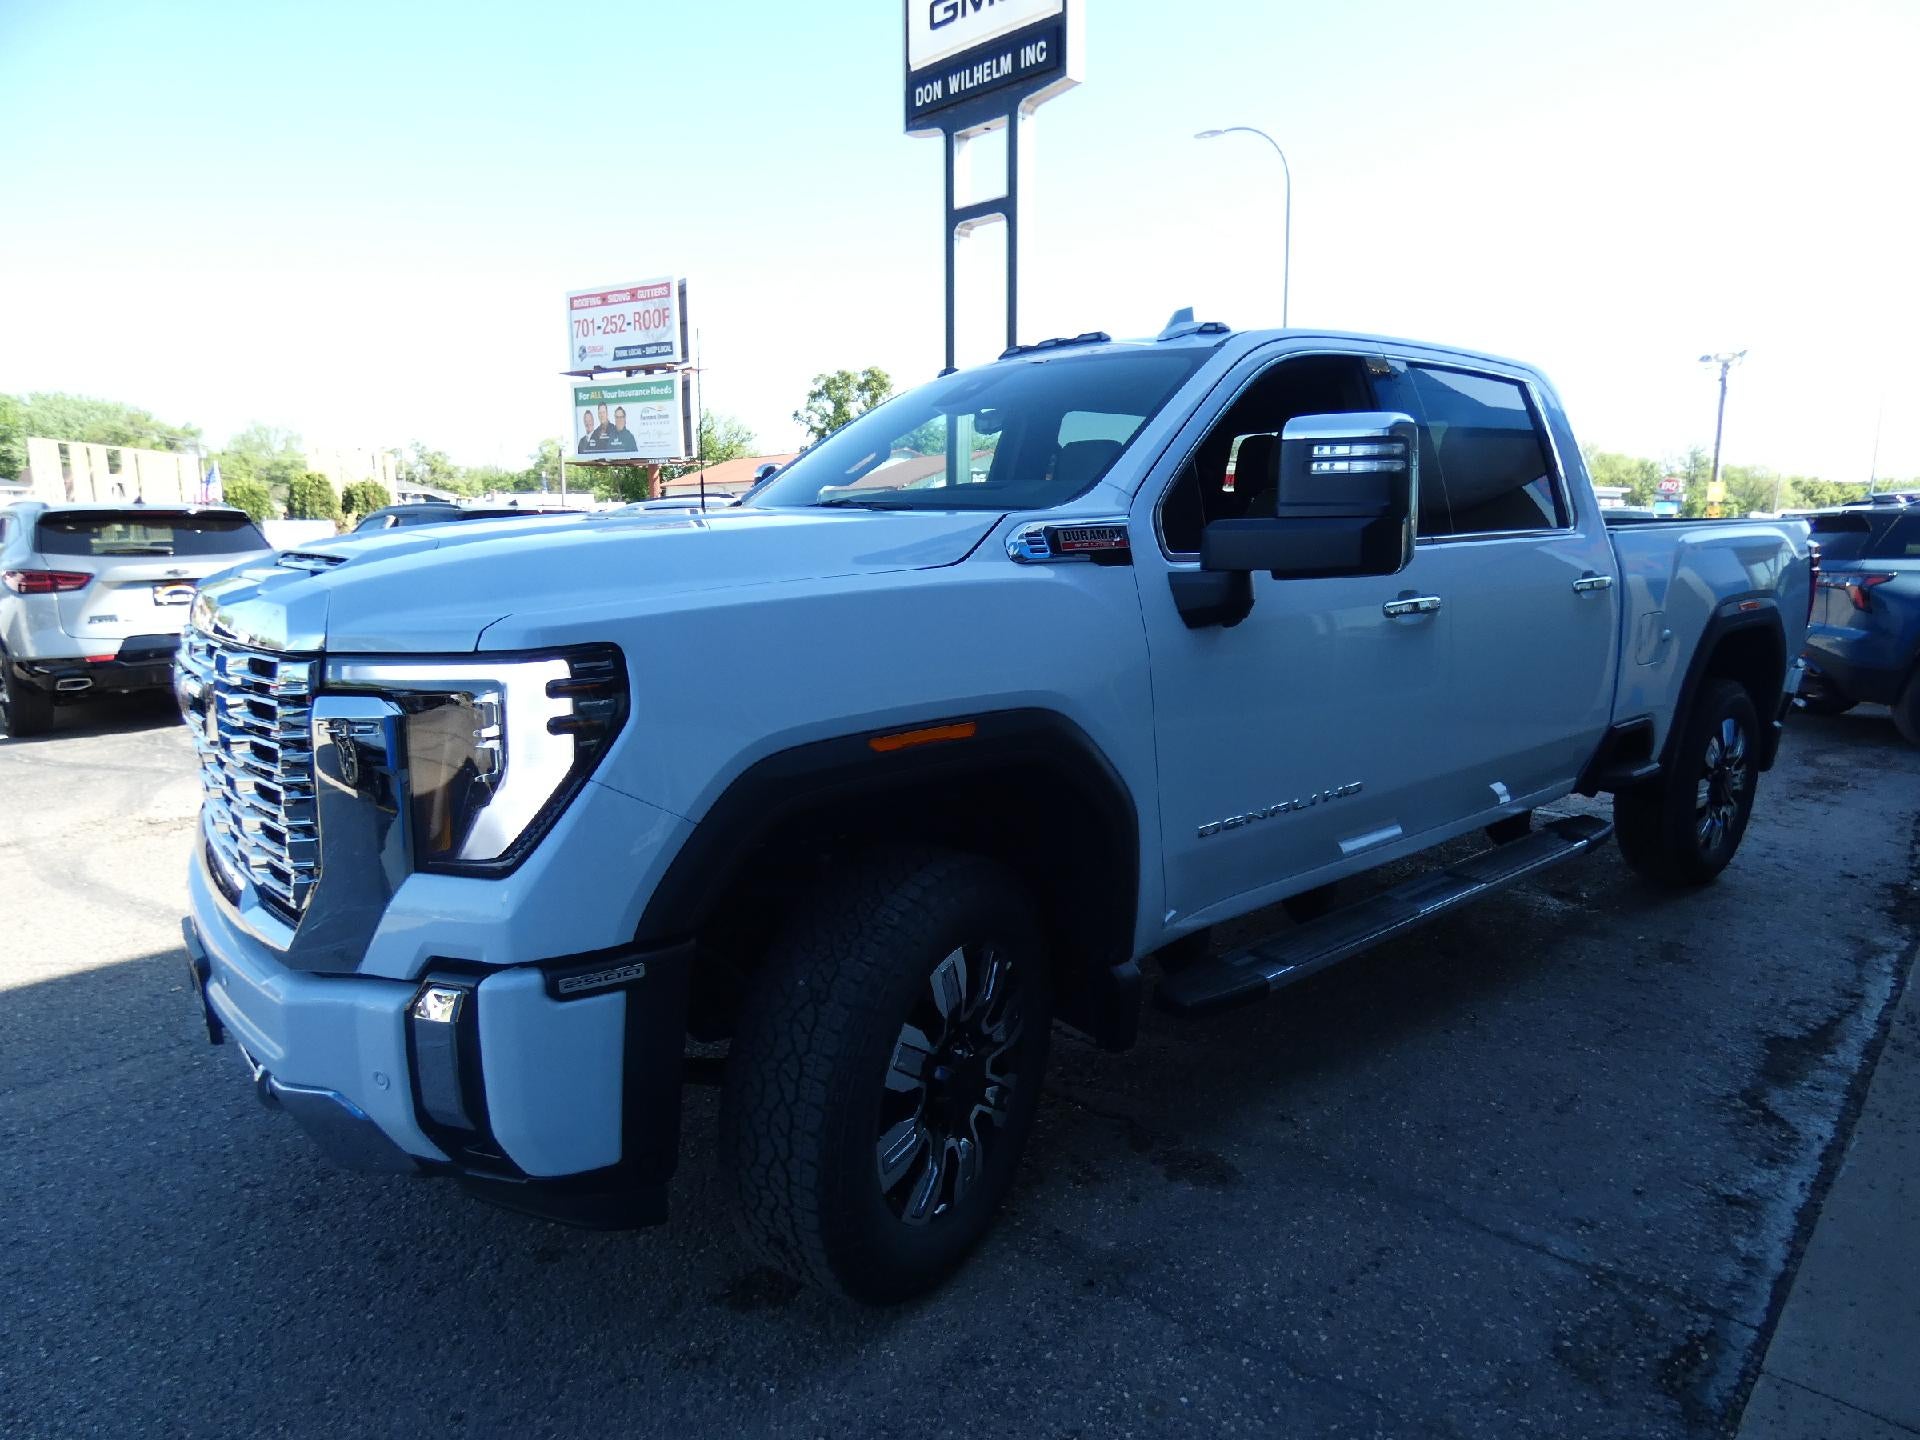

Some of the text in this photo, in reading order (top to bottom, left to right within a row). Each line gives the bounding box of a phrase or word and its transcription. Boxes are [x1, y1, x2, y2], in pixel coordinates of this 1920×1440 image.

[915, 41, 1047, 107] DON WILHELM INC
[637, 286, 669, 299] GUTTERS
[573, 307, 670, 338] 701-252-ROOF
[578, 392, 589, 400] For
[602, 390, 617, 399] Your
[618, 388, 650, 398] Insurance
[650, 385, 672, 395] Needs
[1062, 527, 1124, 541] DURAMAX
